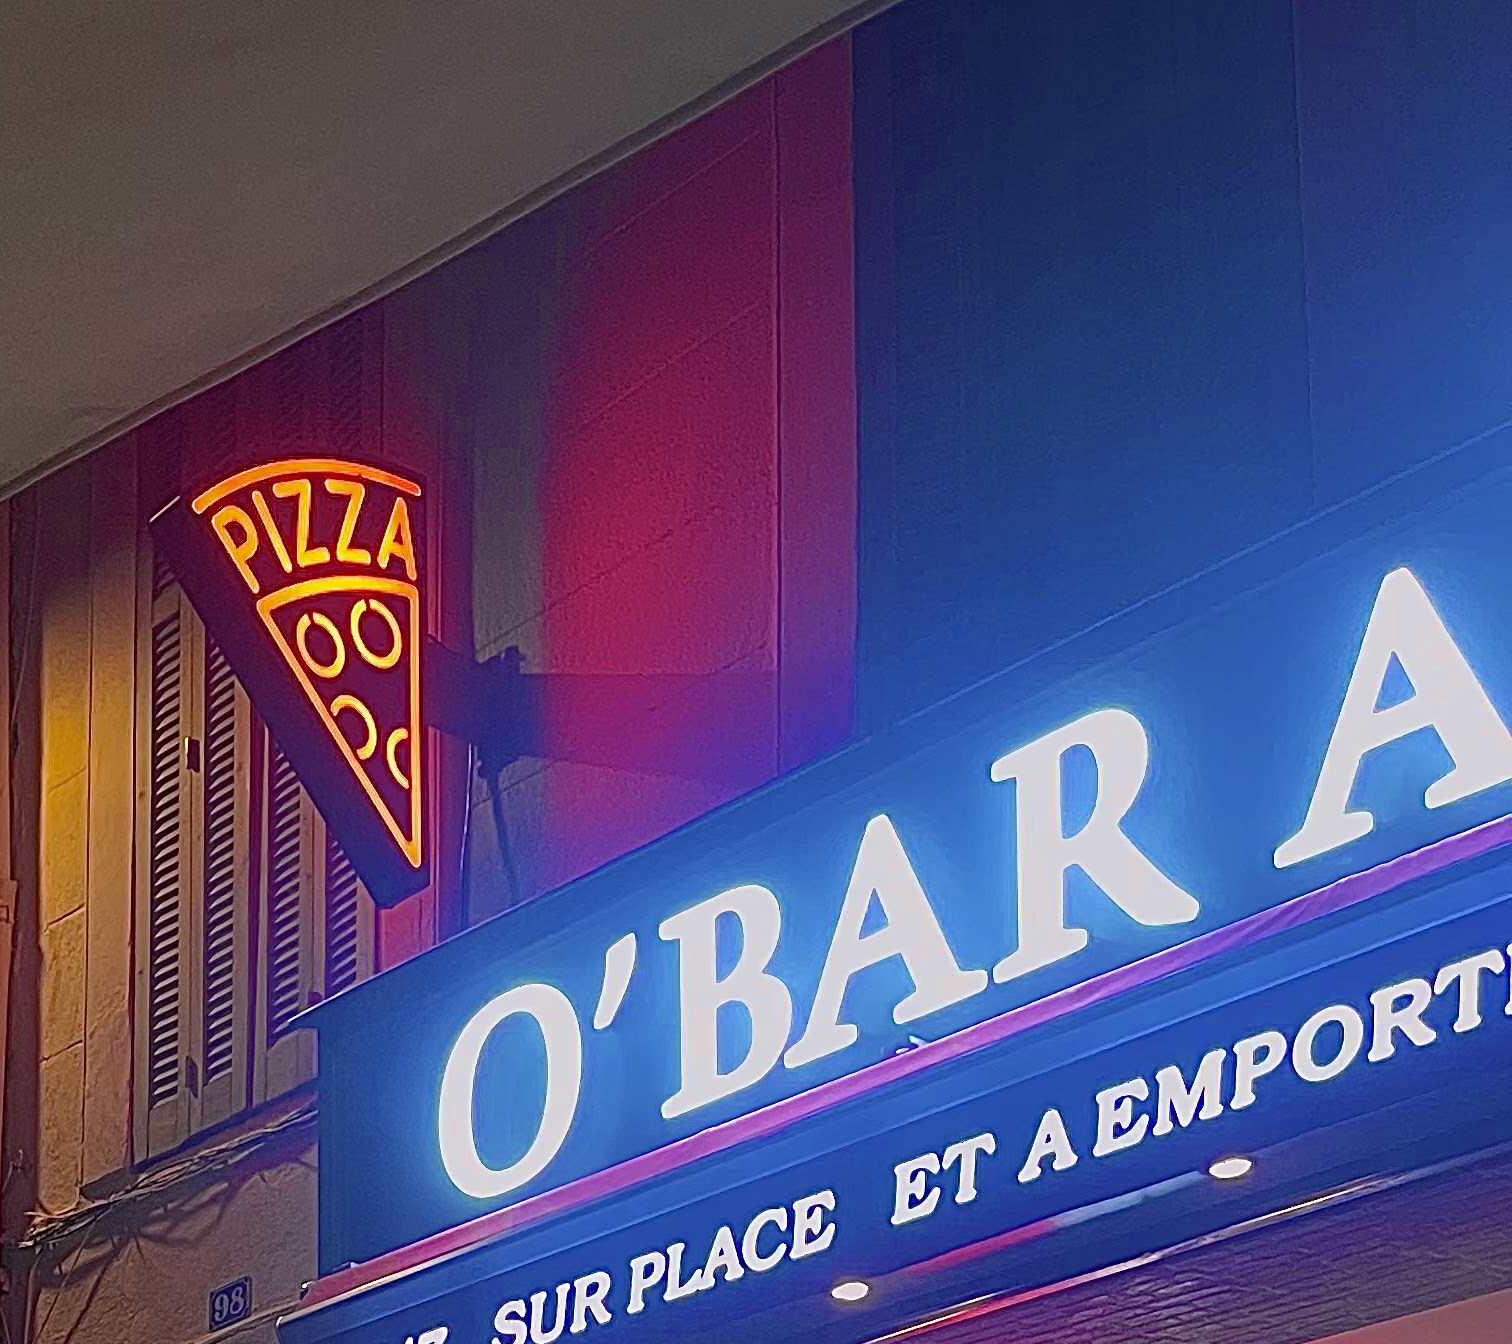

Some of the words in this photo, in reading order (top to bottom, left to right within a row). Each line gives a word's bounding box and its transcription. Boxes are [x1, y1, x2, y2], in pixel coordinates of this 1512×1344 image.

[211, 479, 417, 594] PIZZA
[438, 708, 1199, 1199] O'BAR
[1273, 567, 1512, 868] A
[627, 1190, 835, 1313] PLACE
[891, 1133, 995, 1225] ET
[1018, 1109, 1078, 1182] A
[1092, 943, 1512, 1157] EMPORT
[214, 1286, 246, 1322] 98
